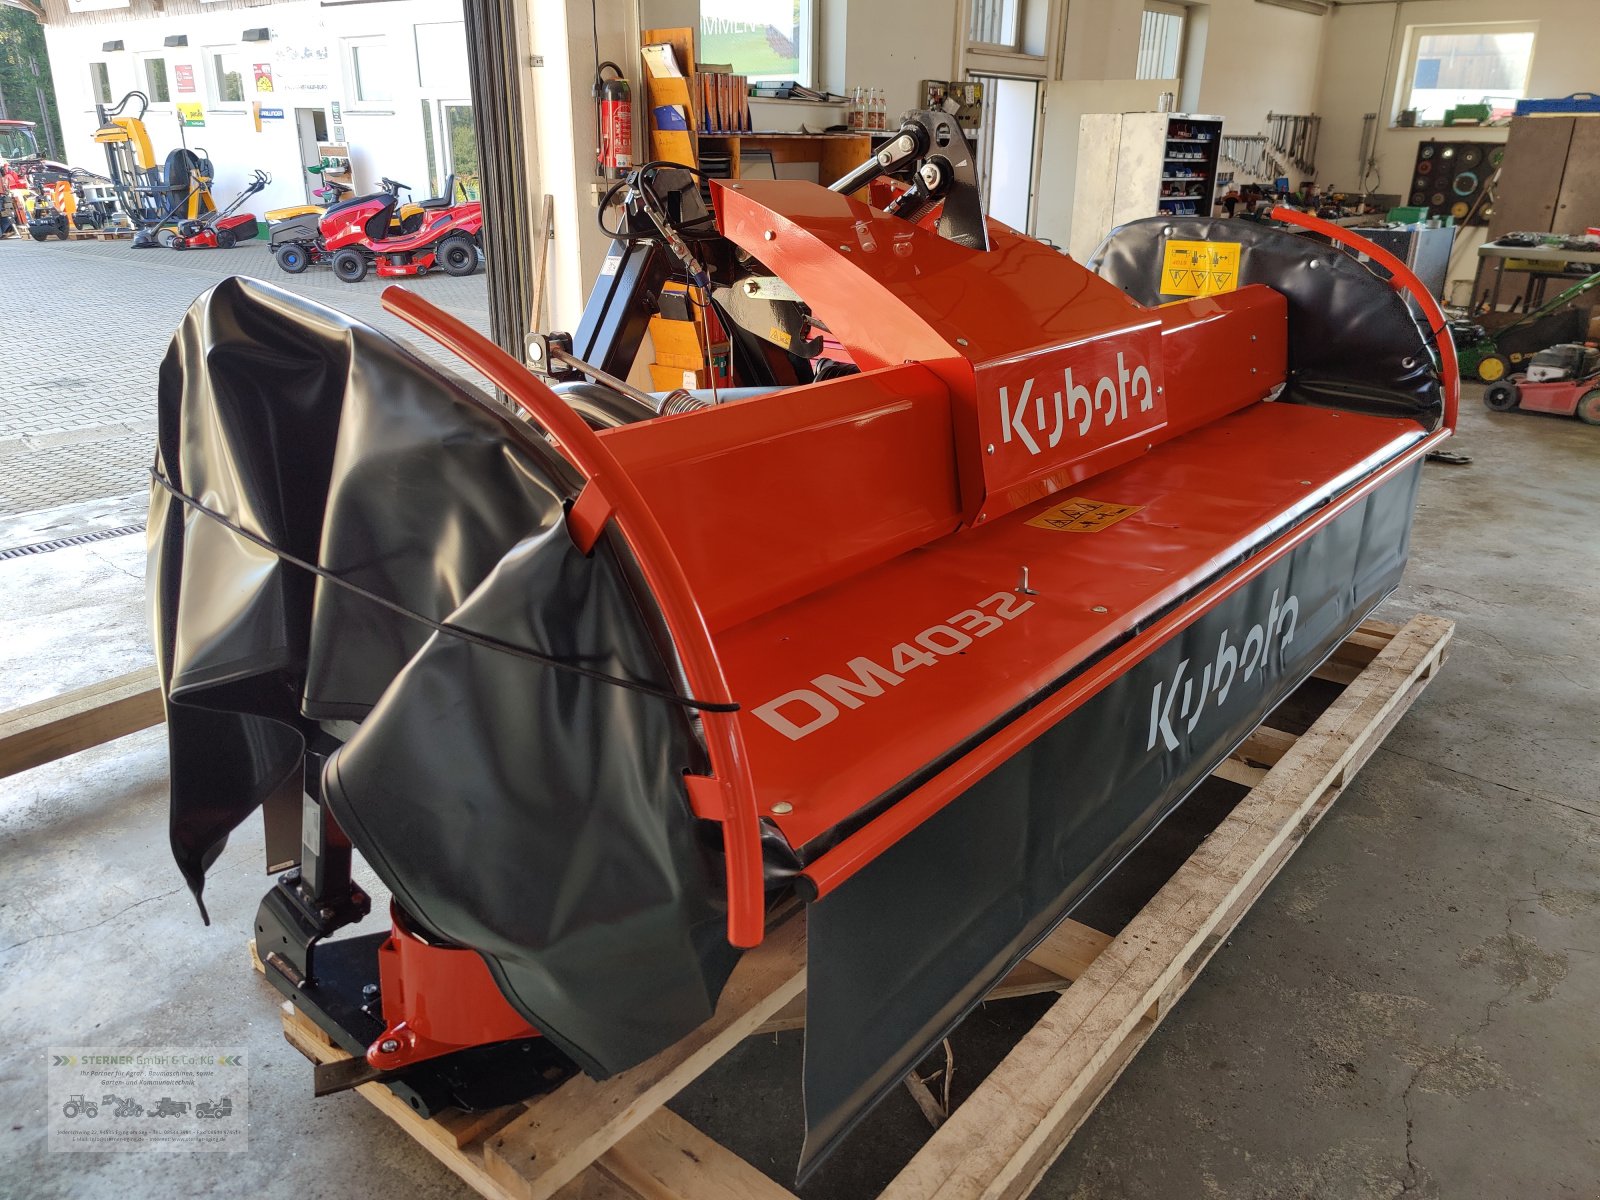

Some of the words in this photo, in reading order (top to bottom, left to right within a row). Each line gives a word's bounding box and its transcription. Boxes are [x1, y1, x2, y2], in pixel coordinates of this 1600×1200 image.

[999, 351, 1154, 456] Kubota
[750, 591, 1035, 741] DM4032
[1146, 588, 1300, 752] Kubota
